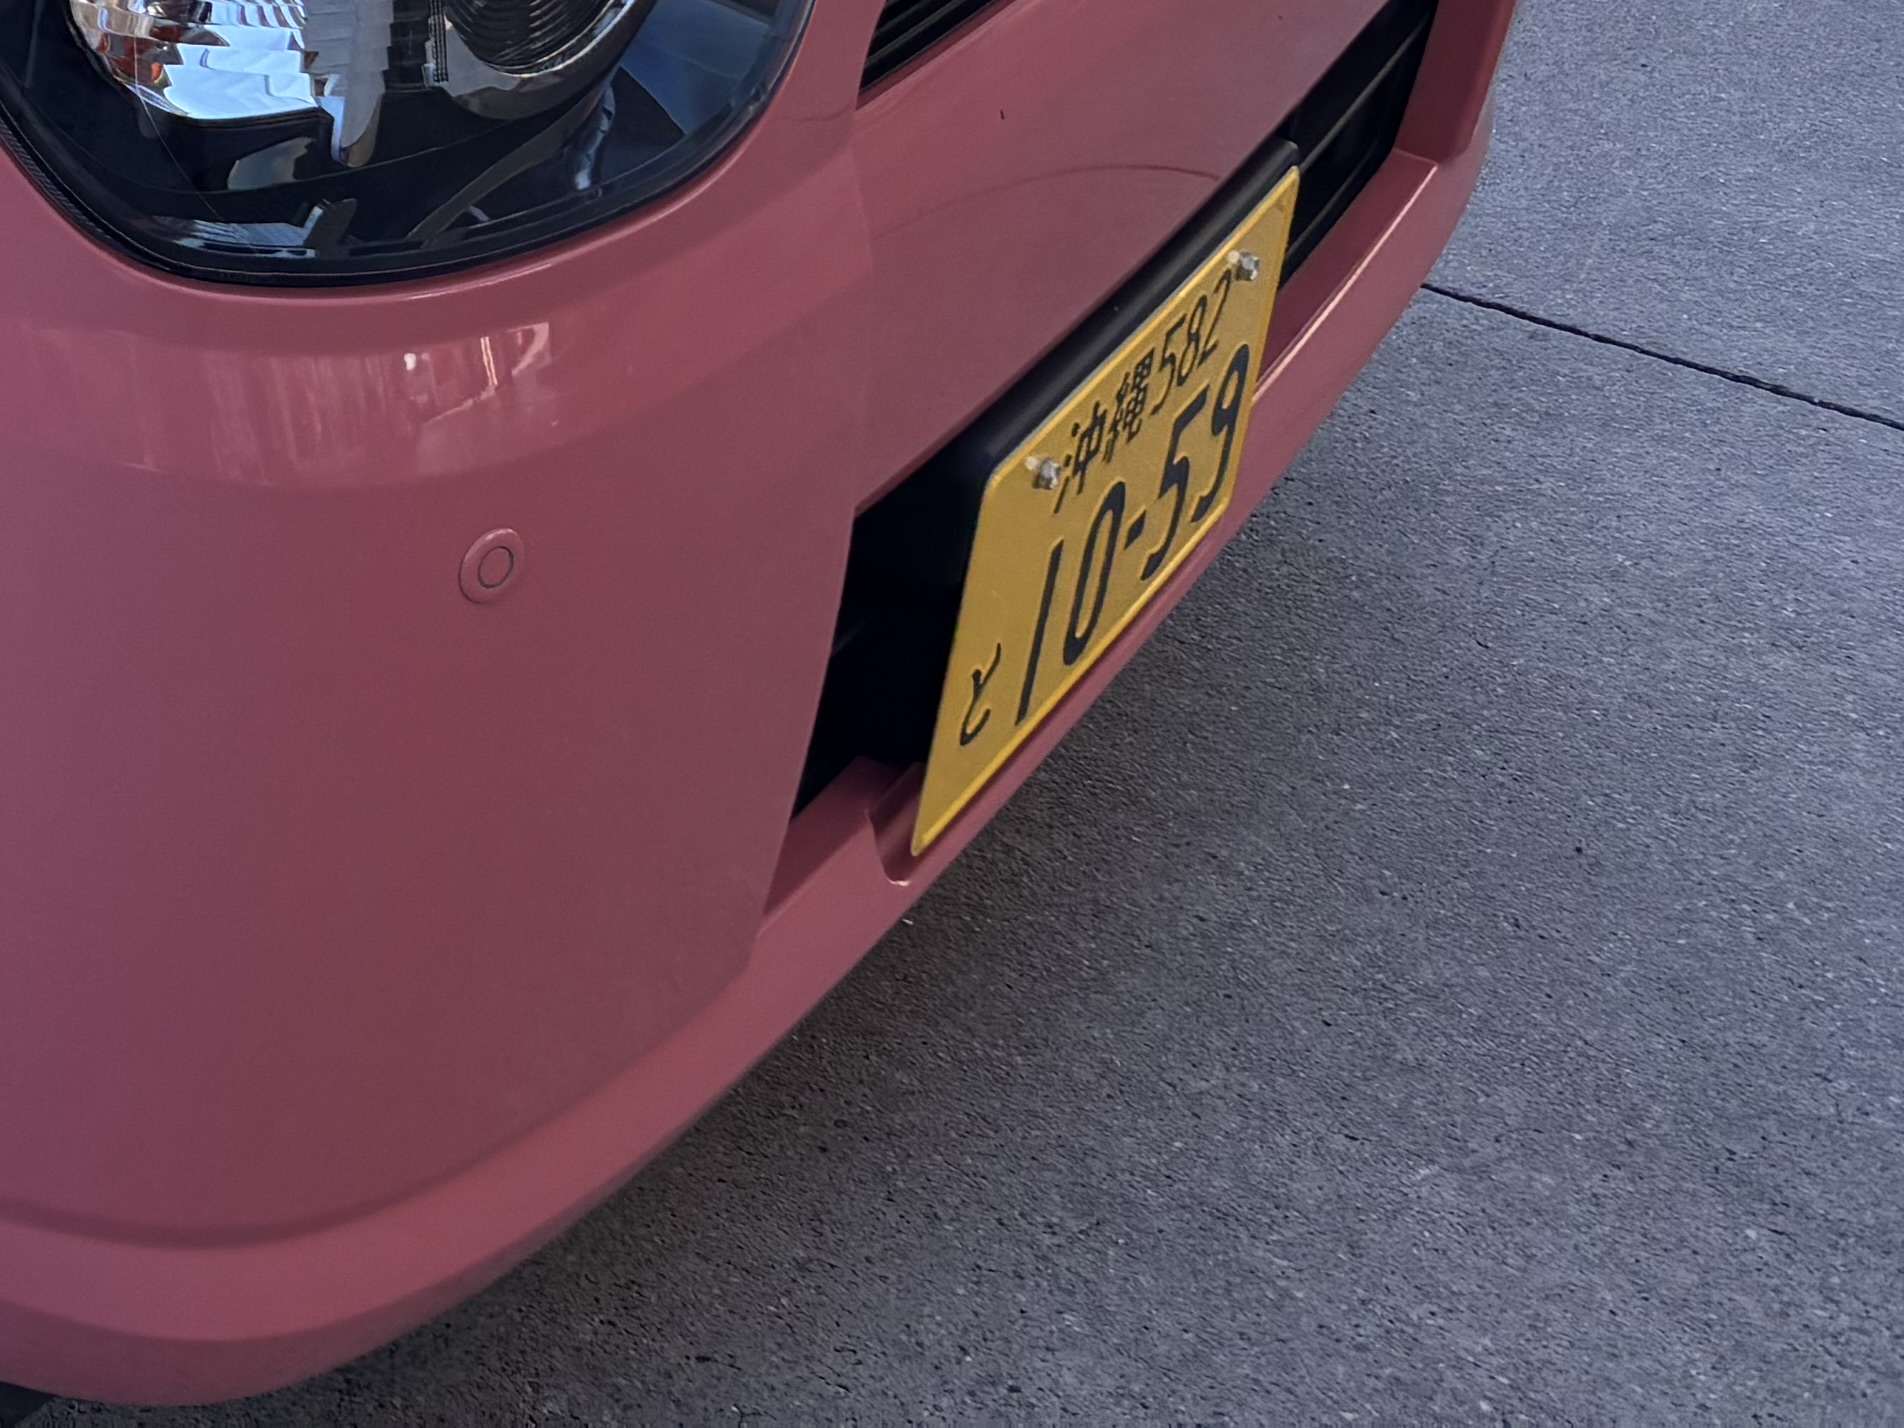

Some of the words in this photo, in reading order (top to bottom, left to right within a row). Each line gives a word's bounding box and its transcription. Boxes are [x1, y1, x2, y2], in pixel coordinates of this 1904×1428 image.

[960, 642, 1002, 746] と
[1015, 343, 1250, 727] 10-59
[1054, 347, 1155, 515] 沖縄
[1150, 268, 1233, 416] 582
